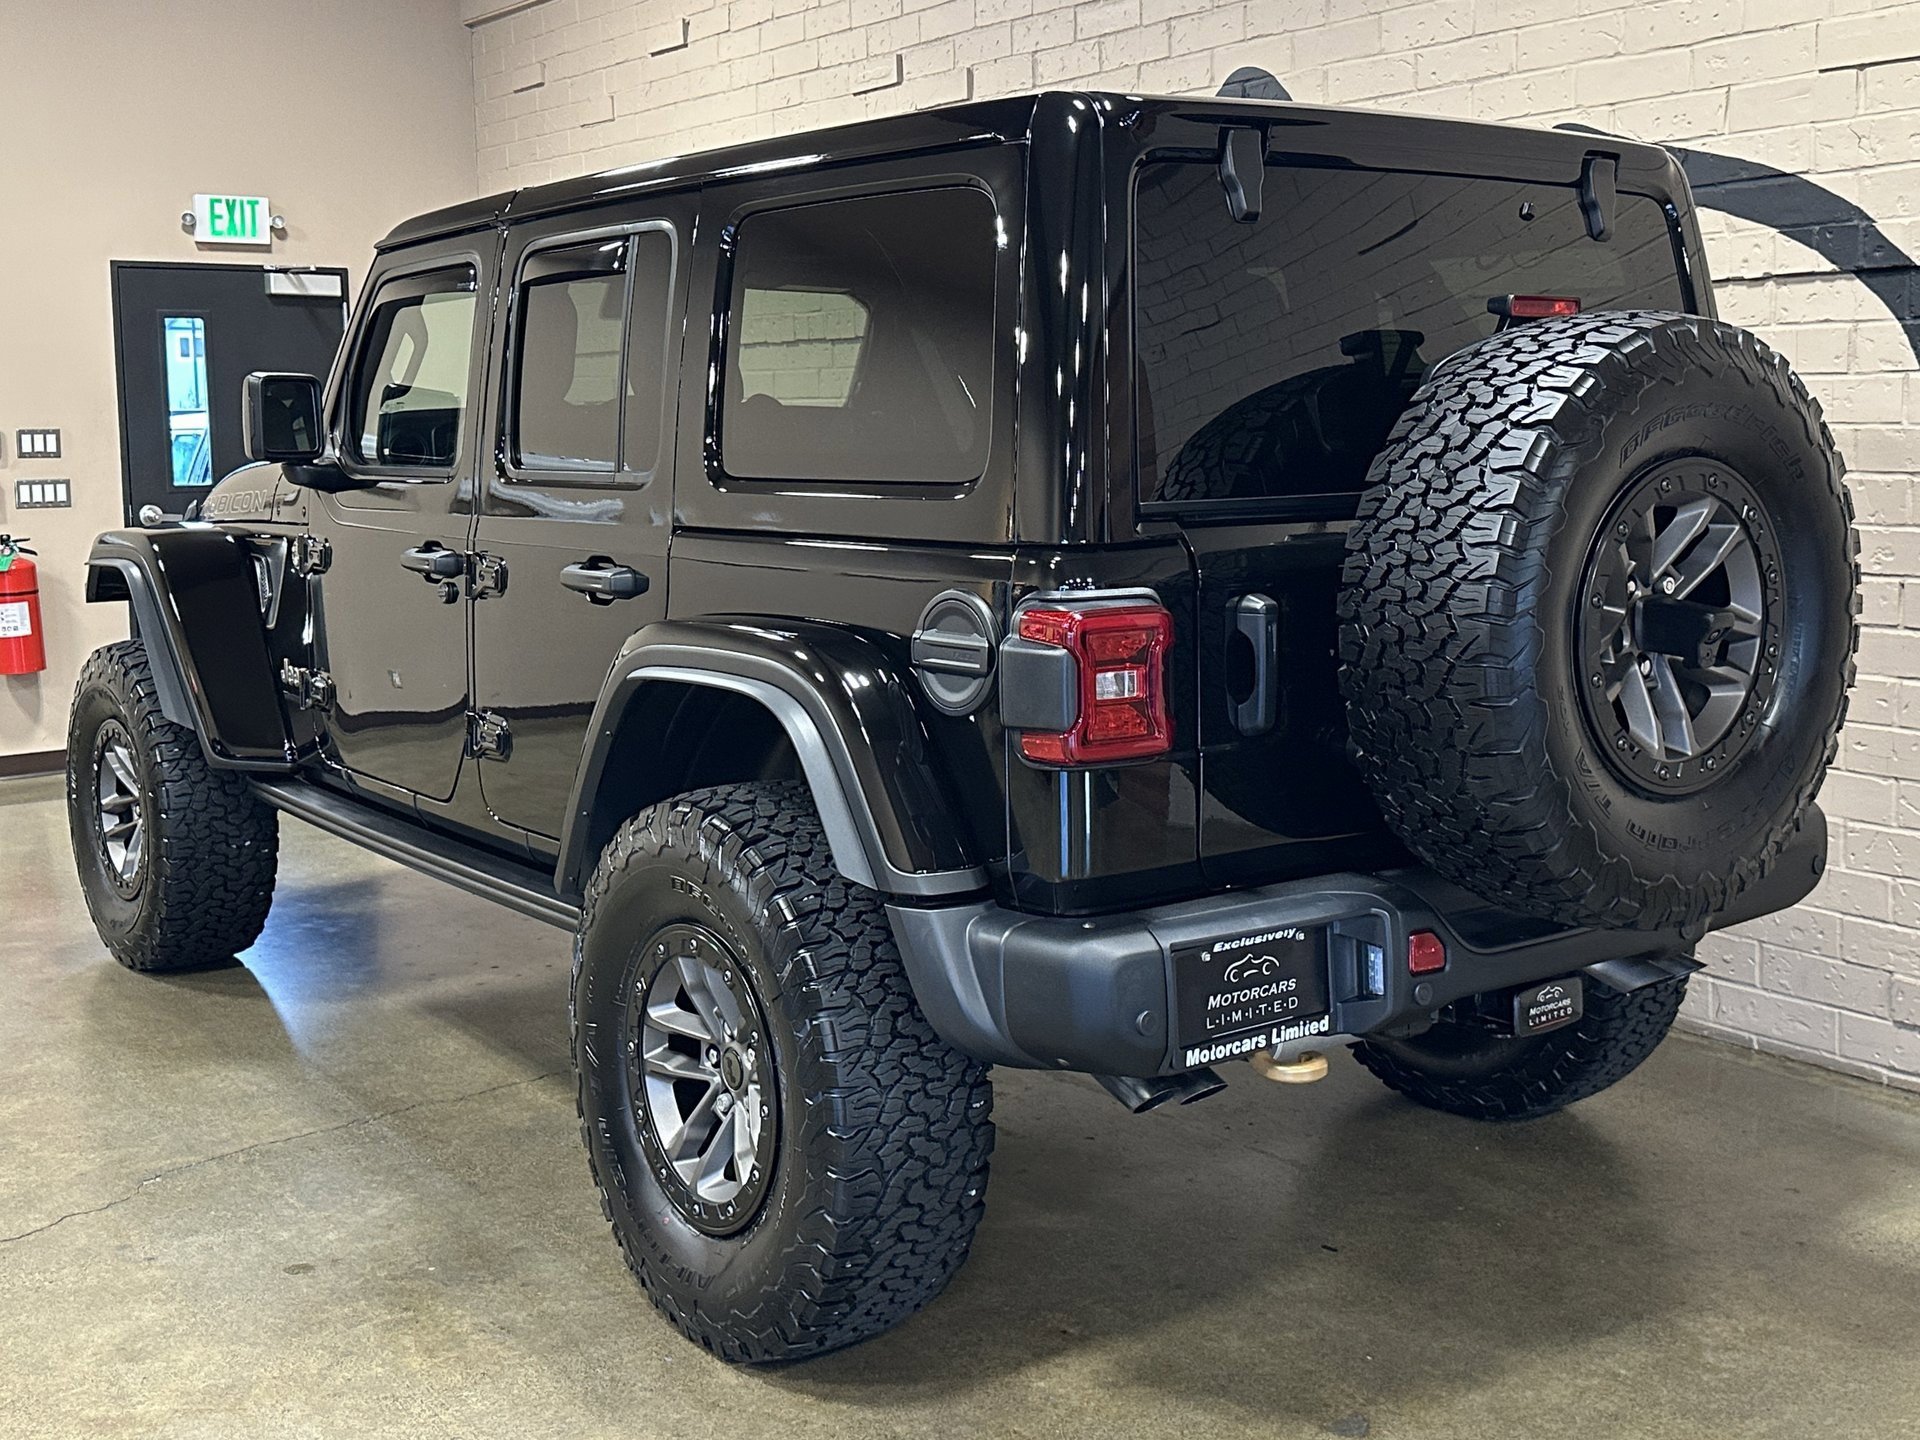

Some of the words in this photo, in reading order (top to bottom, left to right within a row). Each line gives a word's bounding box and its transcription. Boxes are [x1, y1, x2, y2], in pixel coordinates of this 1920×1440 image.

[209, 197, 260, 238] EXIT
[1619, 400, 1806, 485] BFGoodrich
[1212, 927, 1297, 953] Exclusively
[1207, 978, 1297, 1010] MOTORCARS
[1528, 997, 1572, 1016] MOTORCARS
[1528, 1007, 1573, 1026] LIMITED
[1185, 1034, 1267, 1067] Motorcars
[1271, 1014, 1330, 1045] Limited
